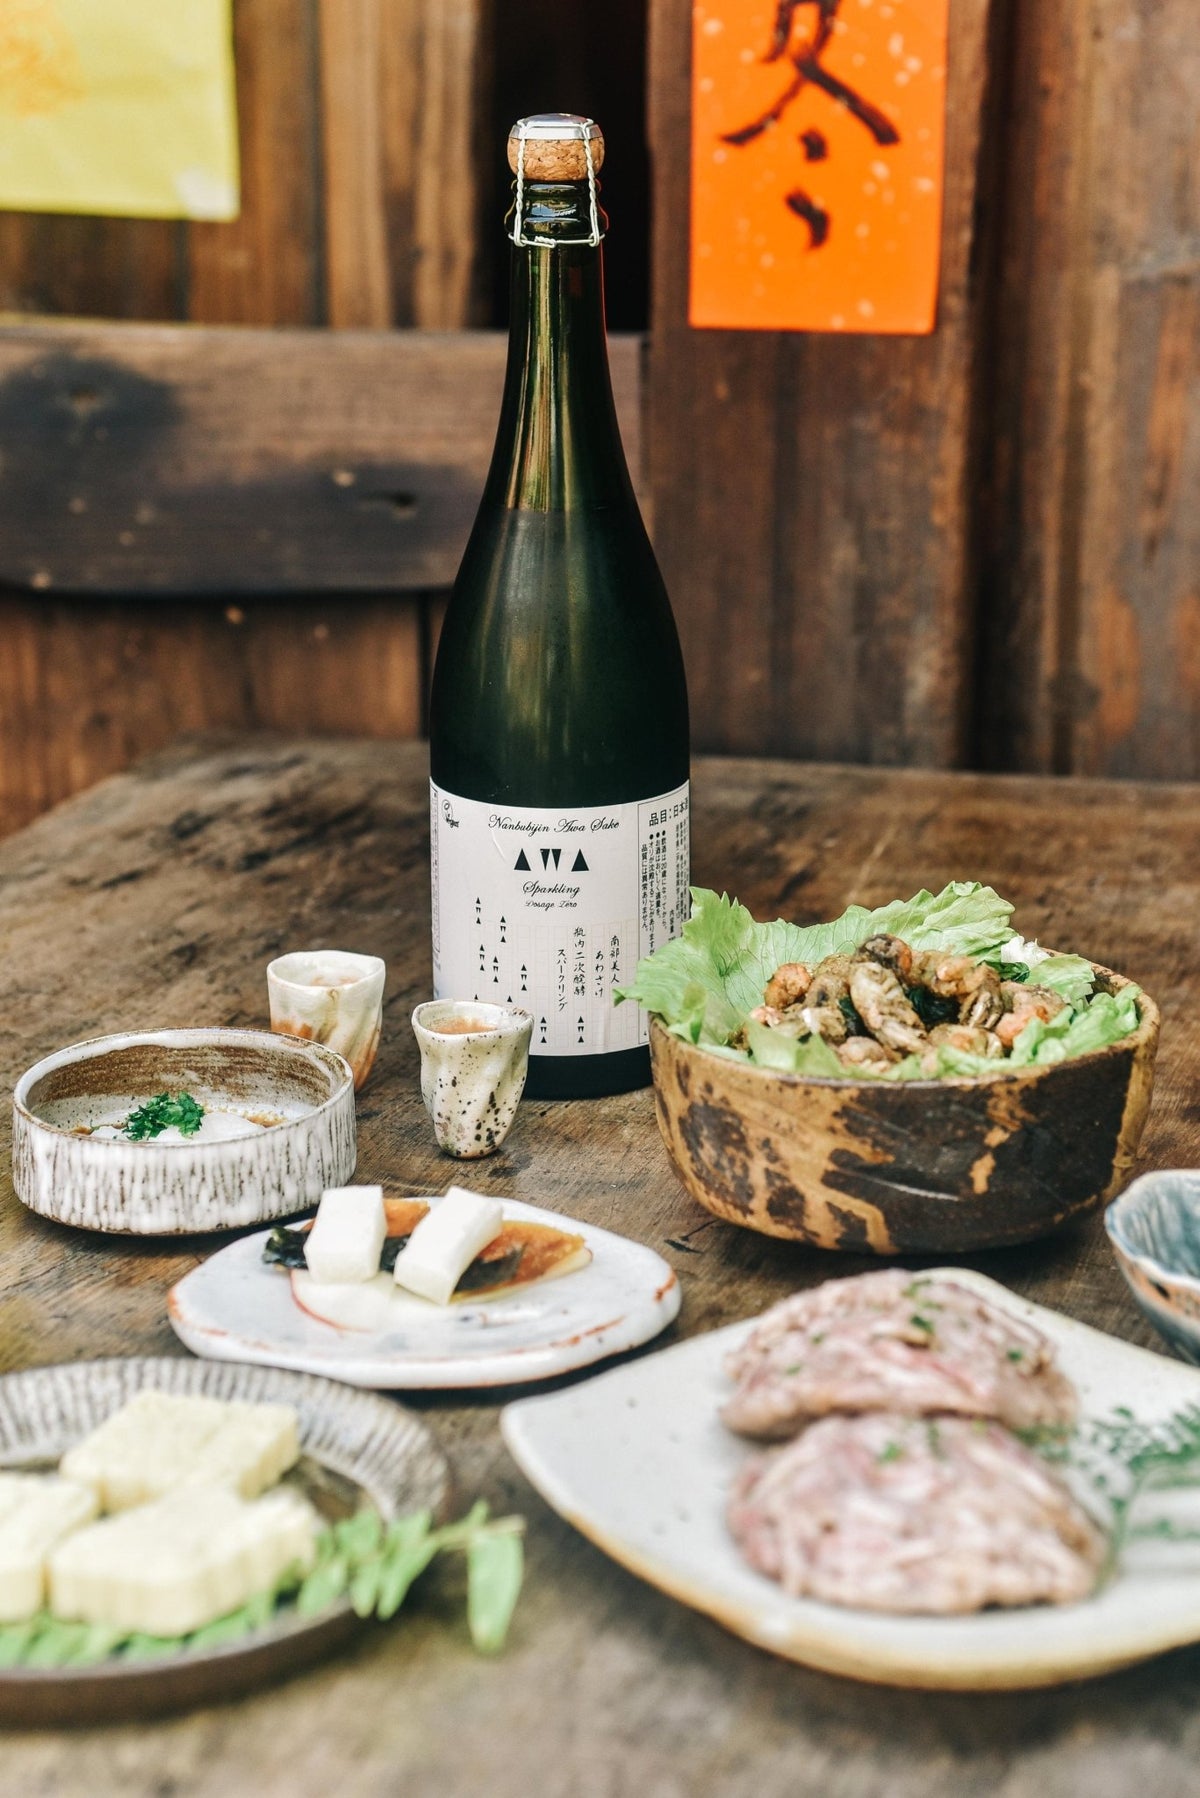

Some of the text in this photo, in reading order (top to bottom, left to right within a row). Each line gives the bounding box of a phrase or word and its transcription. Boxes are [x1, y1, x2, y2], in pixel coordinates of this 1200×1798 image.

[488, 814, 620, 837] Nanbubijin Awa Sake
[523, 880, 580, 900] Sparkling
[525, 900, 556, 912] Dosage
[594, 950, 605, 998] あわさけ
[609, 935, 620, 984] 南部美人
[556, 949, 568, 1012] スパークリング
